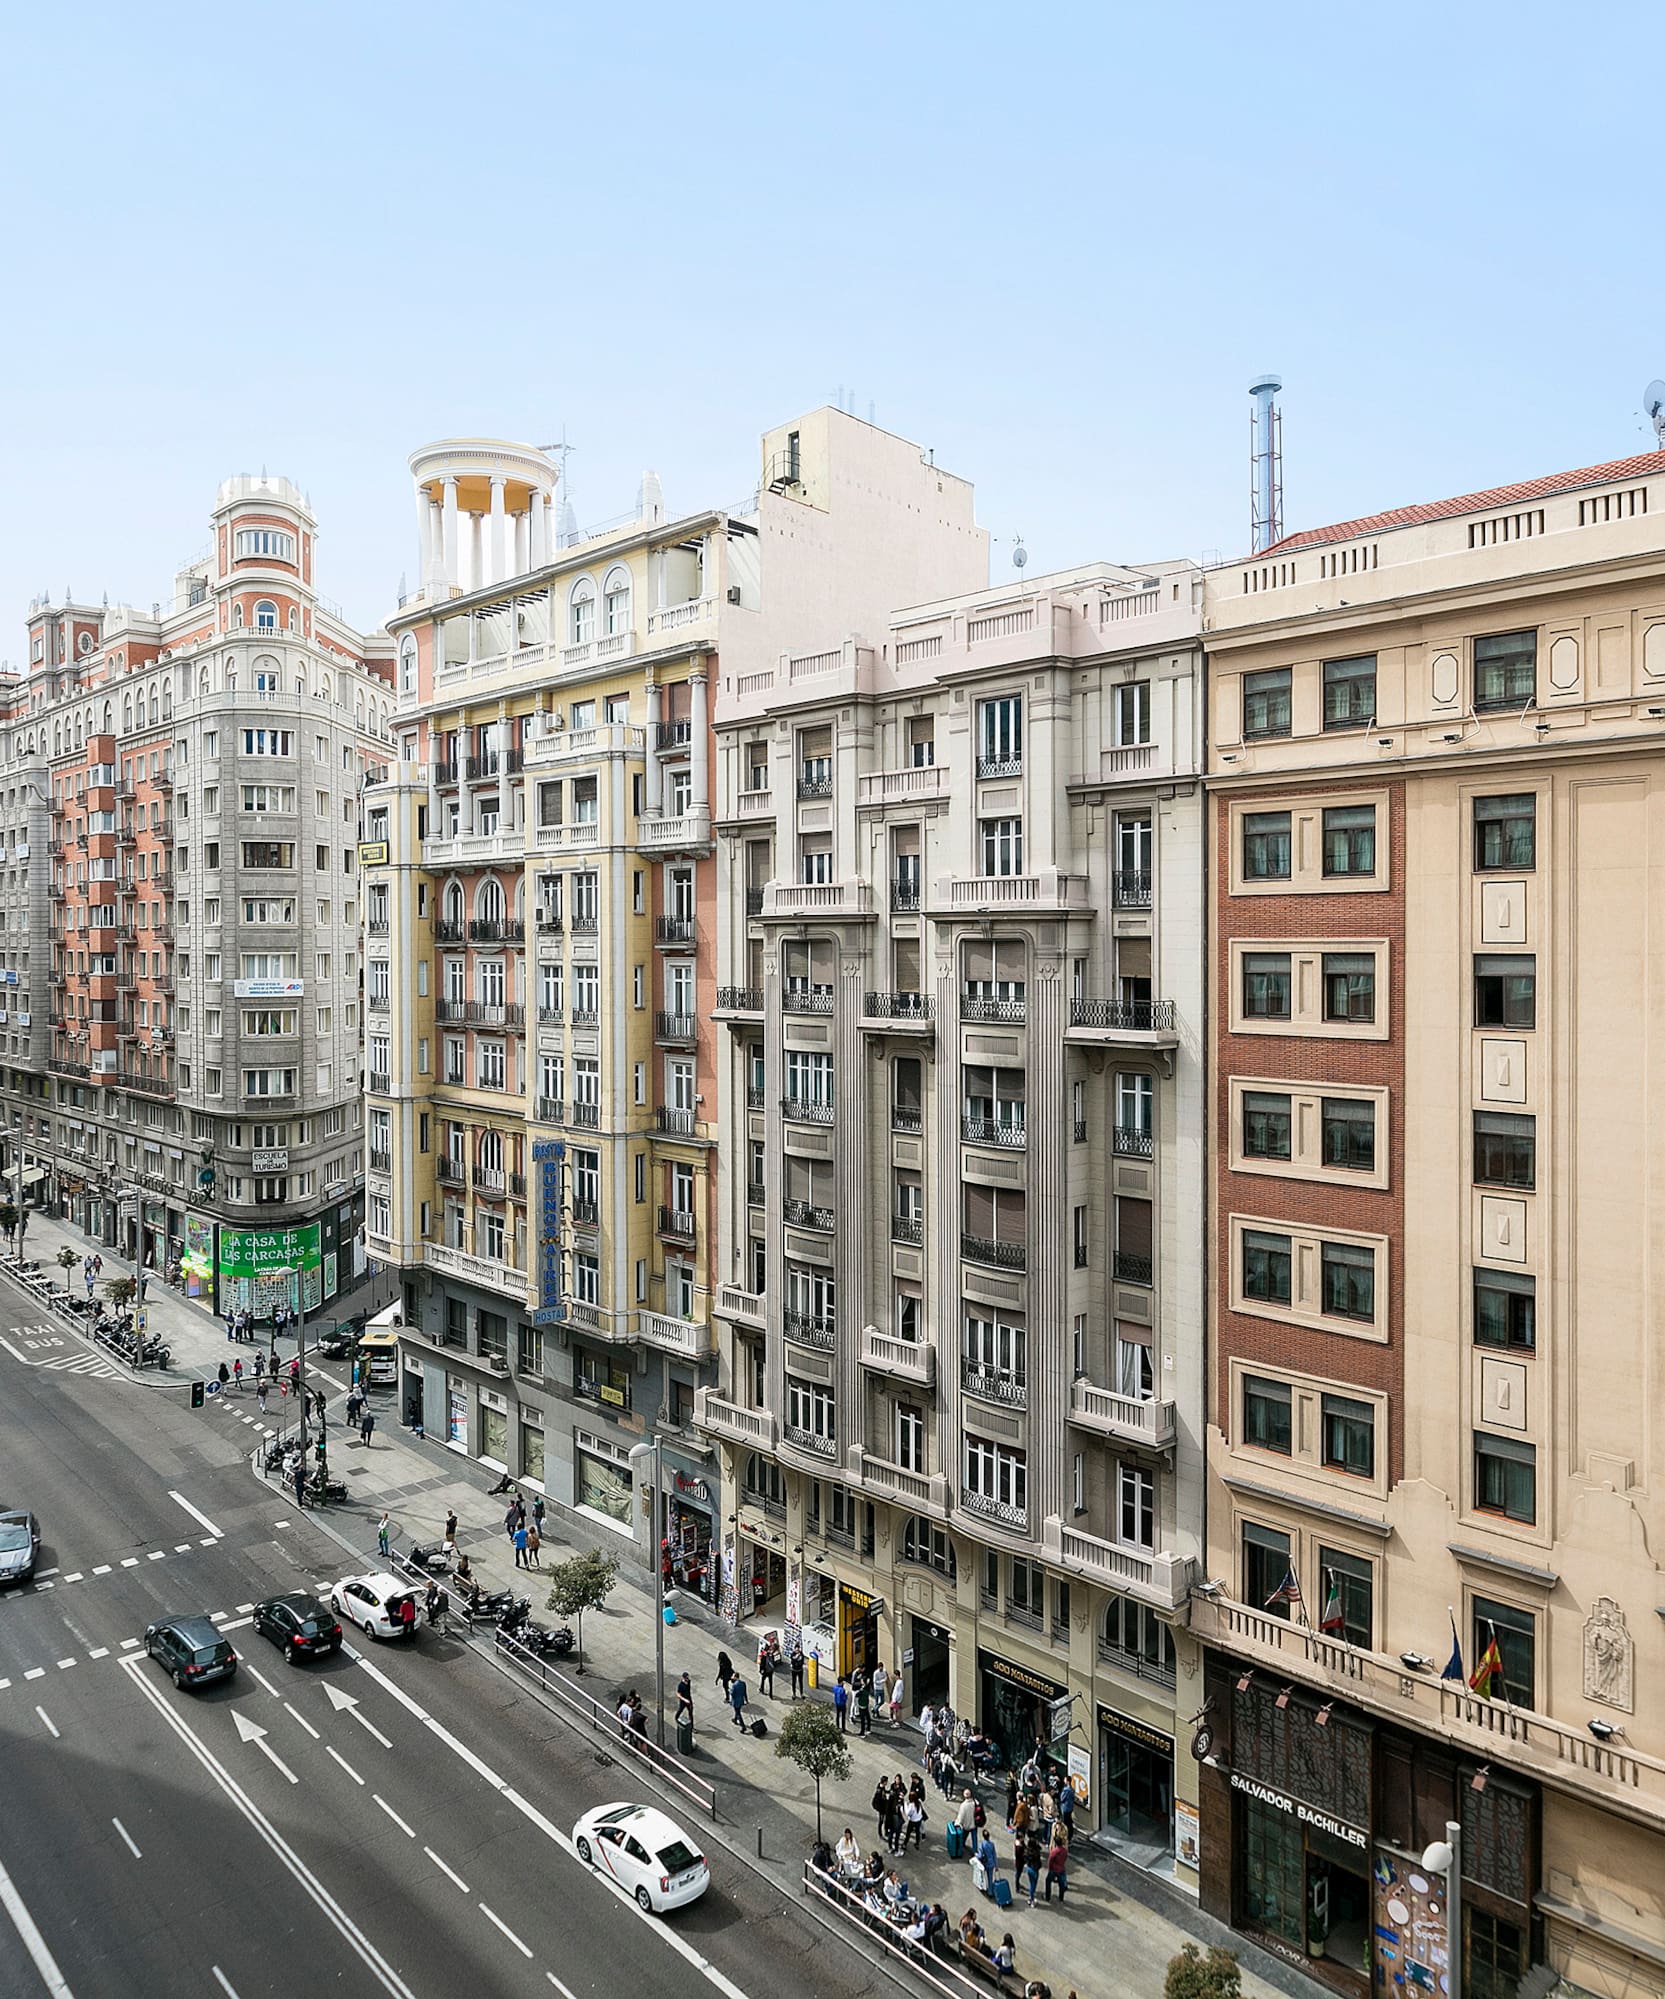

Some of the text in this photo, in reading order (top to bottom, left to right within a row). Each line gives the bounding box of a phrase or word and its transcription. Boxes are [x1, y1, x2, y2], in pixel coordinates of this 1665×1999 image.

[254, 1152, 287, 1160] ESCUELA
[255, 1163, 286, 1171] TURISMO
[229, 1233, 298, 1247] LA CASA DE
[543, 1161, 557, 1308] BUENOS AIRES
[244, 1246, 305, 1261] CARCASAS
[535, 1309, 566, 1324] HOSTAL
[9, 1324, 56, 1336] TAXI
[24, 1337, 65, 1349] BUS
[851, 1595, 869, 1609] UNIO
[1230, 1774, 1367, 1849] SALVADOR BACHILLER
